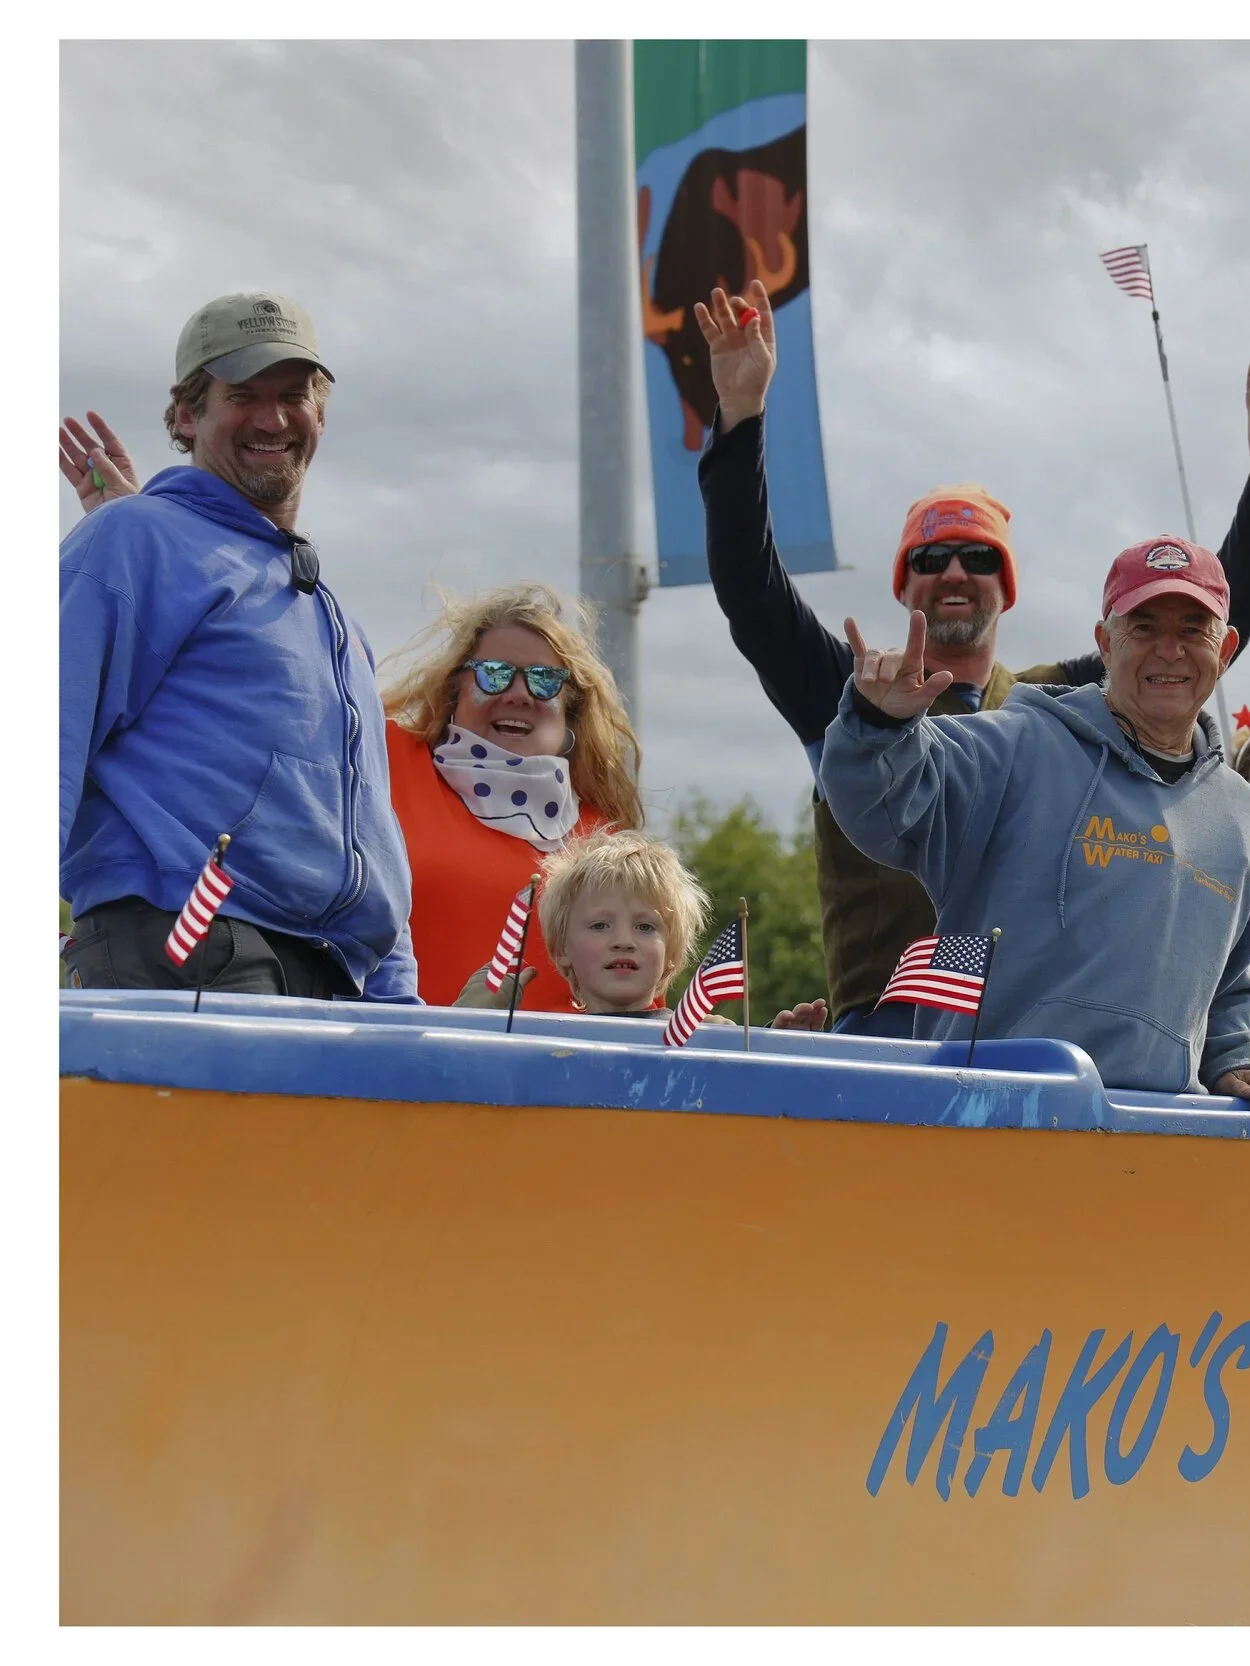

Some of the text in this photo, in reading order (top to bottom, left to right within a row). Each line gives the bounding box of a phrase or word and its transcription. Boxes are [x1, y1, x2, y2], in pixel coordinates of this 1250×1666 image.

[1084, 815, 1147, 845] MAKO'S
[1082, 842, 1163, 869] WATER TAXI
